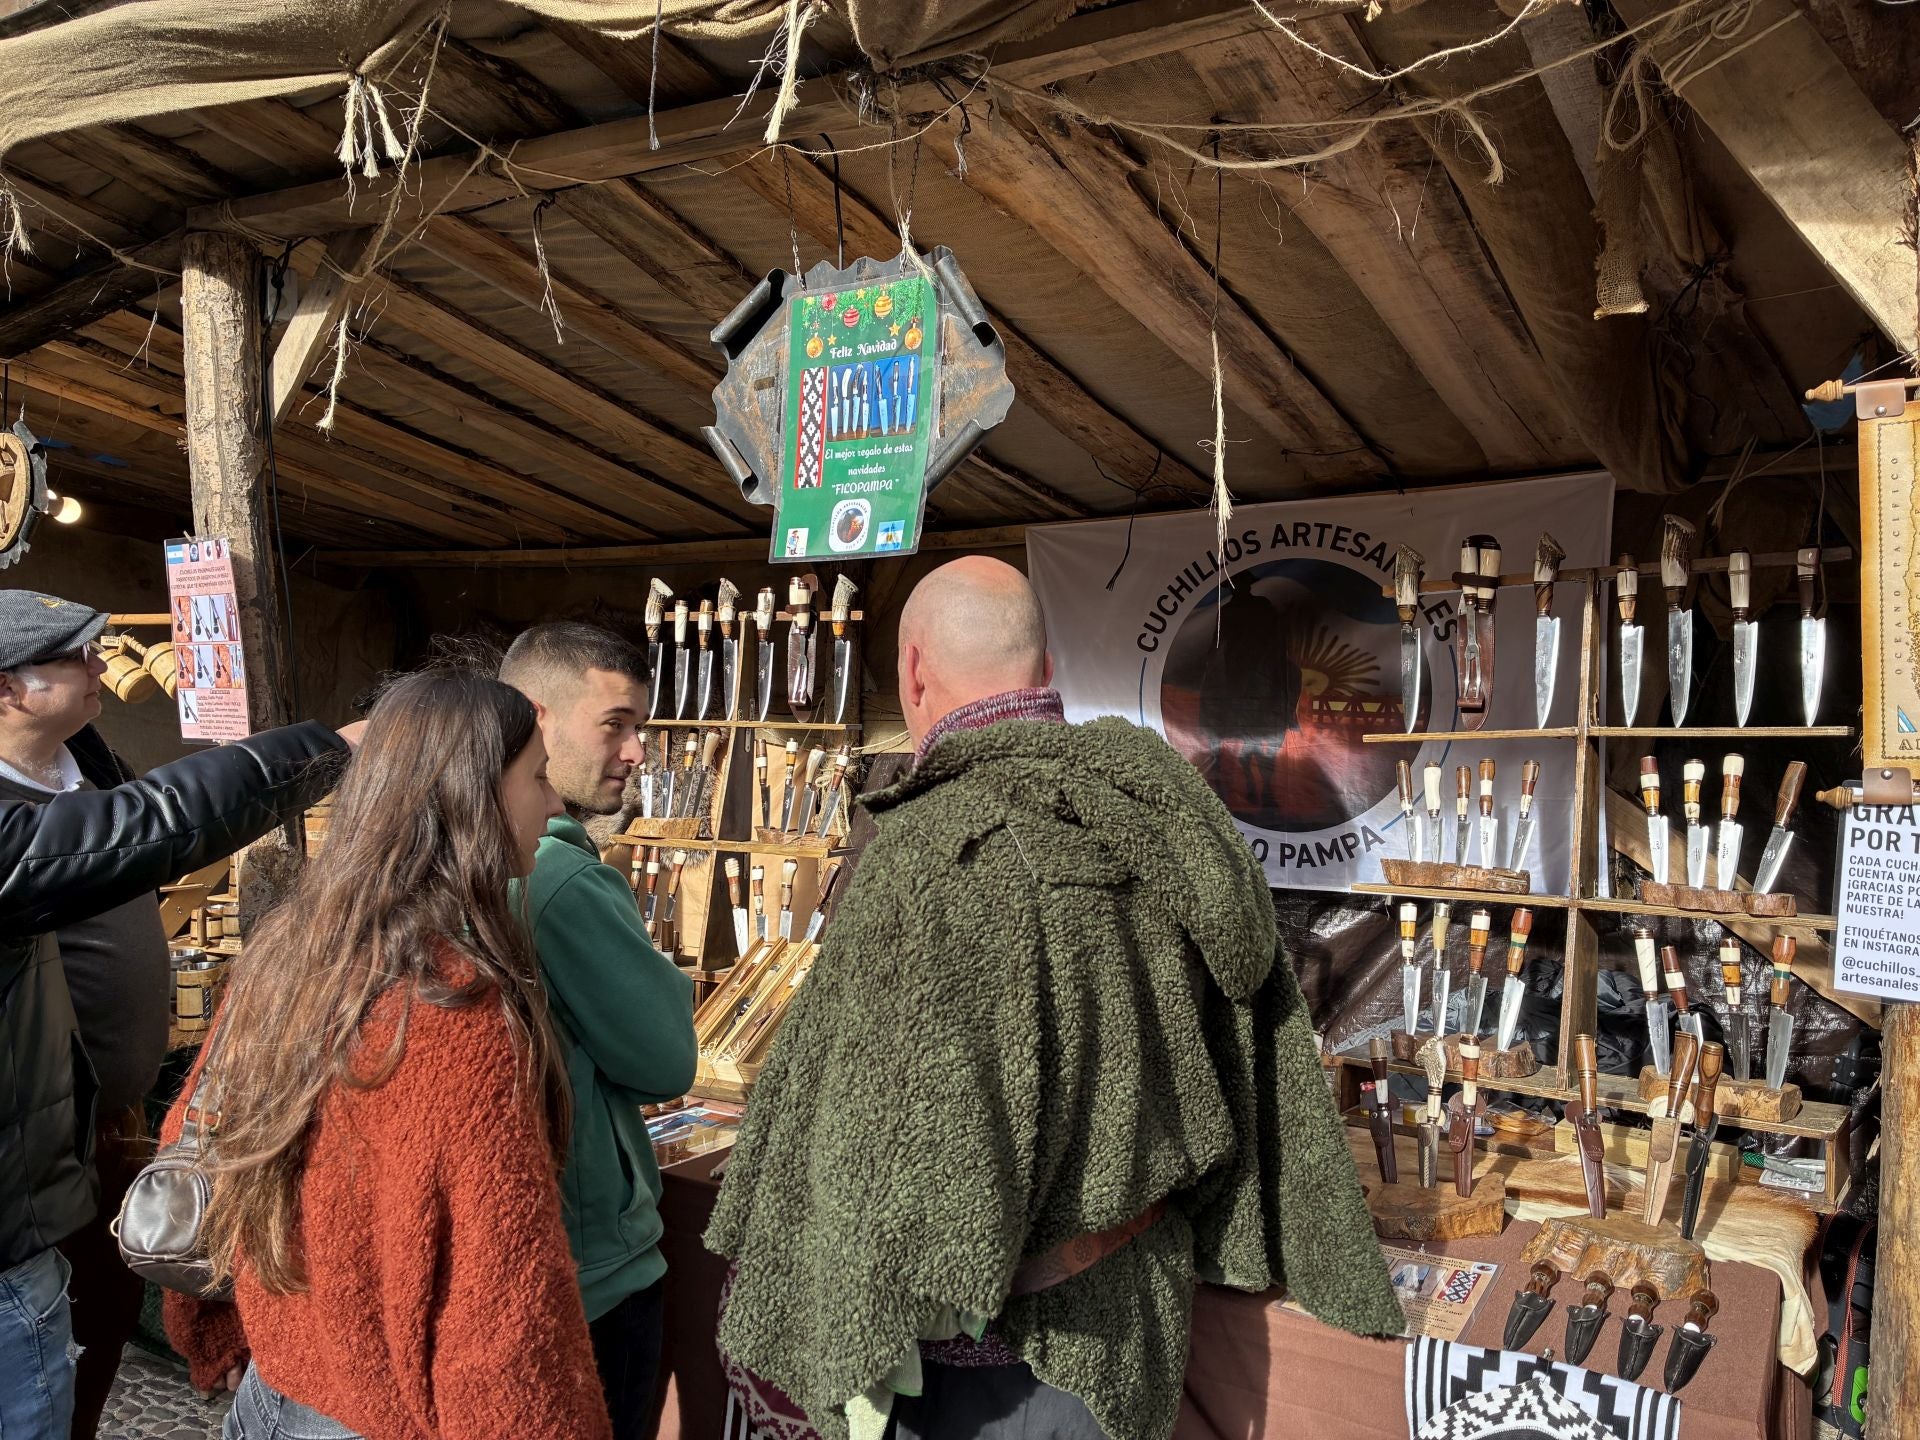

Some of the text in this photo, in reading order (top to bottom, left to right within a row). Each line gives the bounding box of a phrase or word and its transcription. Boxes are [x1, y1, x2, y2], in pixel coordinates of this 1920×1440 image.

[830, 339, 897, 359] Feliz Navidad
[825, 444, 913, 461] El mejor regalo de estas
[848, 463, 886, 476] navidades
[1891, 458, 1902, 675] OCEANO PACIFICO
[1137, 522, 1458, 653] CUCHILLOS ARTESANES
[1280, 824, 1385, 869] PAMPA
[1850, 827, 1901, 852] POR
[1849, 855, 1918, 871] CADA CUCH
[1848, 867, 1894, 881] CUENTA
[1848, 879, 1904, 894] ¡GRACIAS
[1847, 891, 1920, 909] PARTE DE LA
[1846, 904, 1904, 919] NUESTRA!
[1844, 925, 1920, 945] ETIQUÉTANOS
[1844, 937, 1920, 956] EN INSTAGRA
[1841, 972, 1919, 992] artesanales
